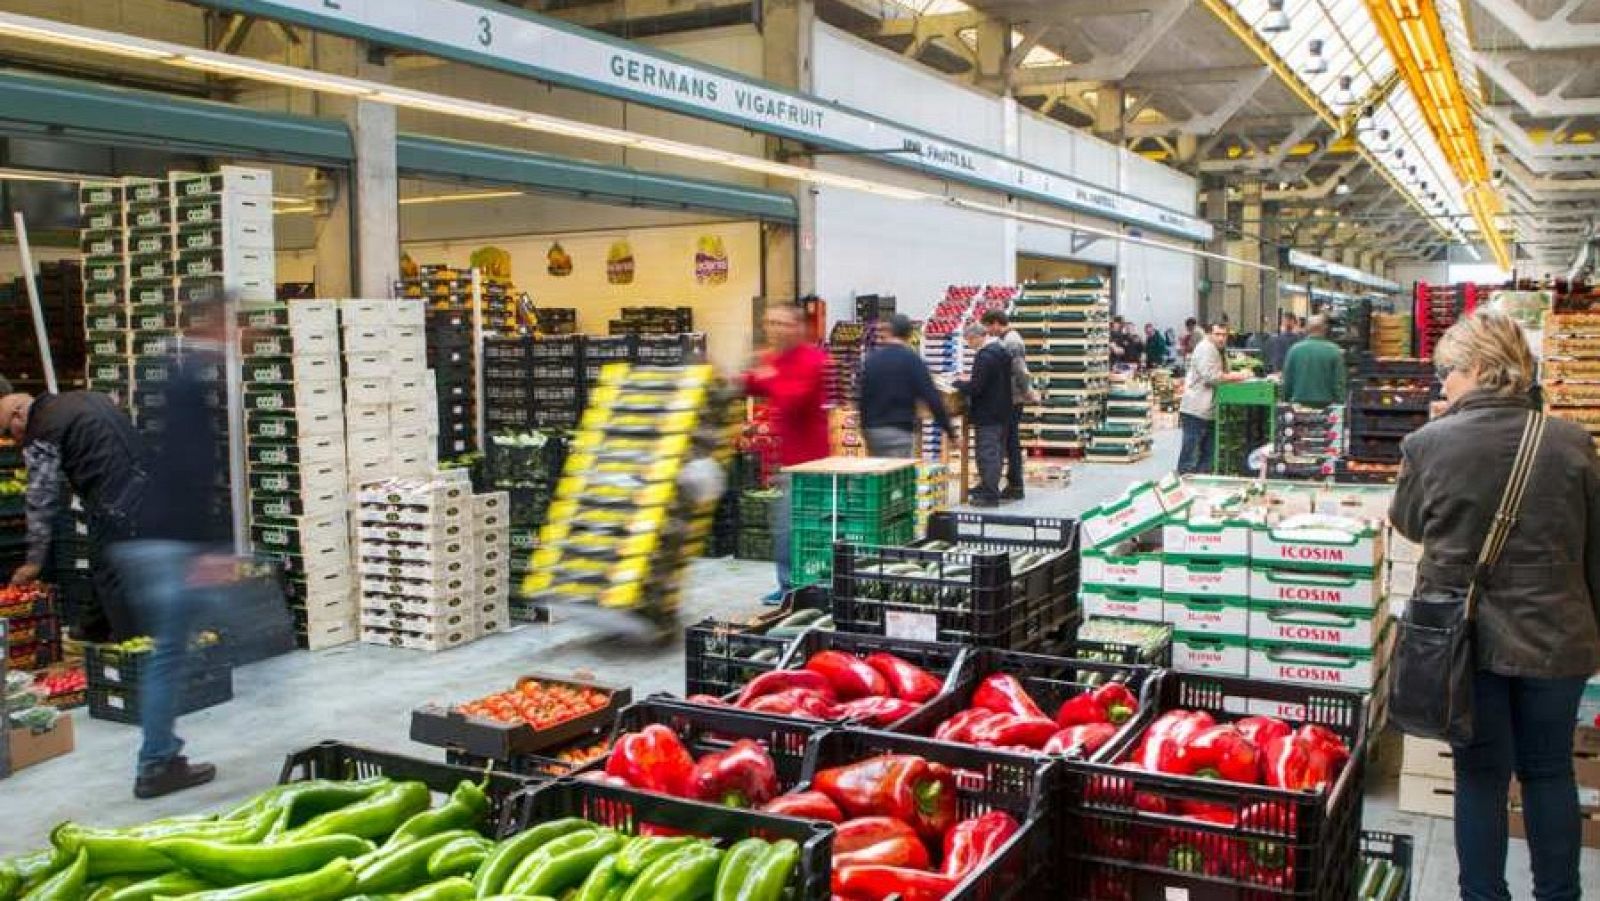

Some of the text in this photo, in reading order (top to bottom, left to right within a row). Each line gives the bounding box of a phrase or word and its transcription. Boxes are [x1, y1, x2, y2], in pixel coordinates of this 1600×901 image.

[478, 16, 492, 46] 3
[611, 55, 825, 128] GERMANS VIGAFRUIT
[1280, 545, 1345, 561] ICOSIM
[1278, 587, 1341, 603] ICOSIM
[1278, 626, 1341, 642] ICOSIM
[1278, 666, 1341, 682] ICOSIM
